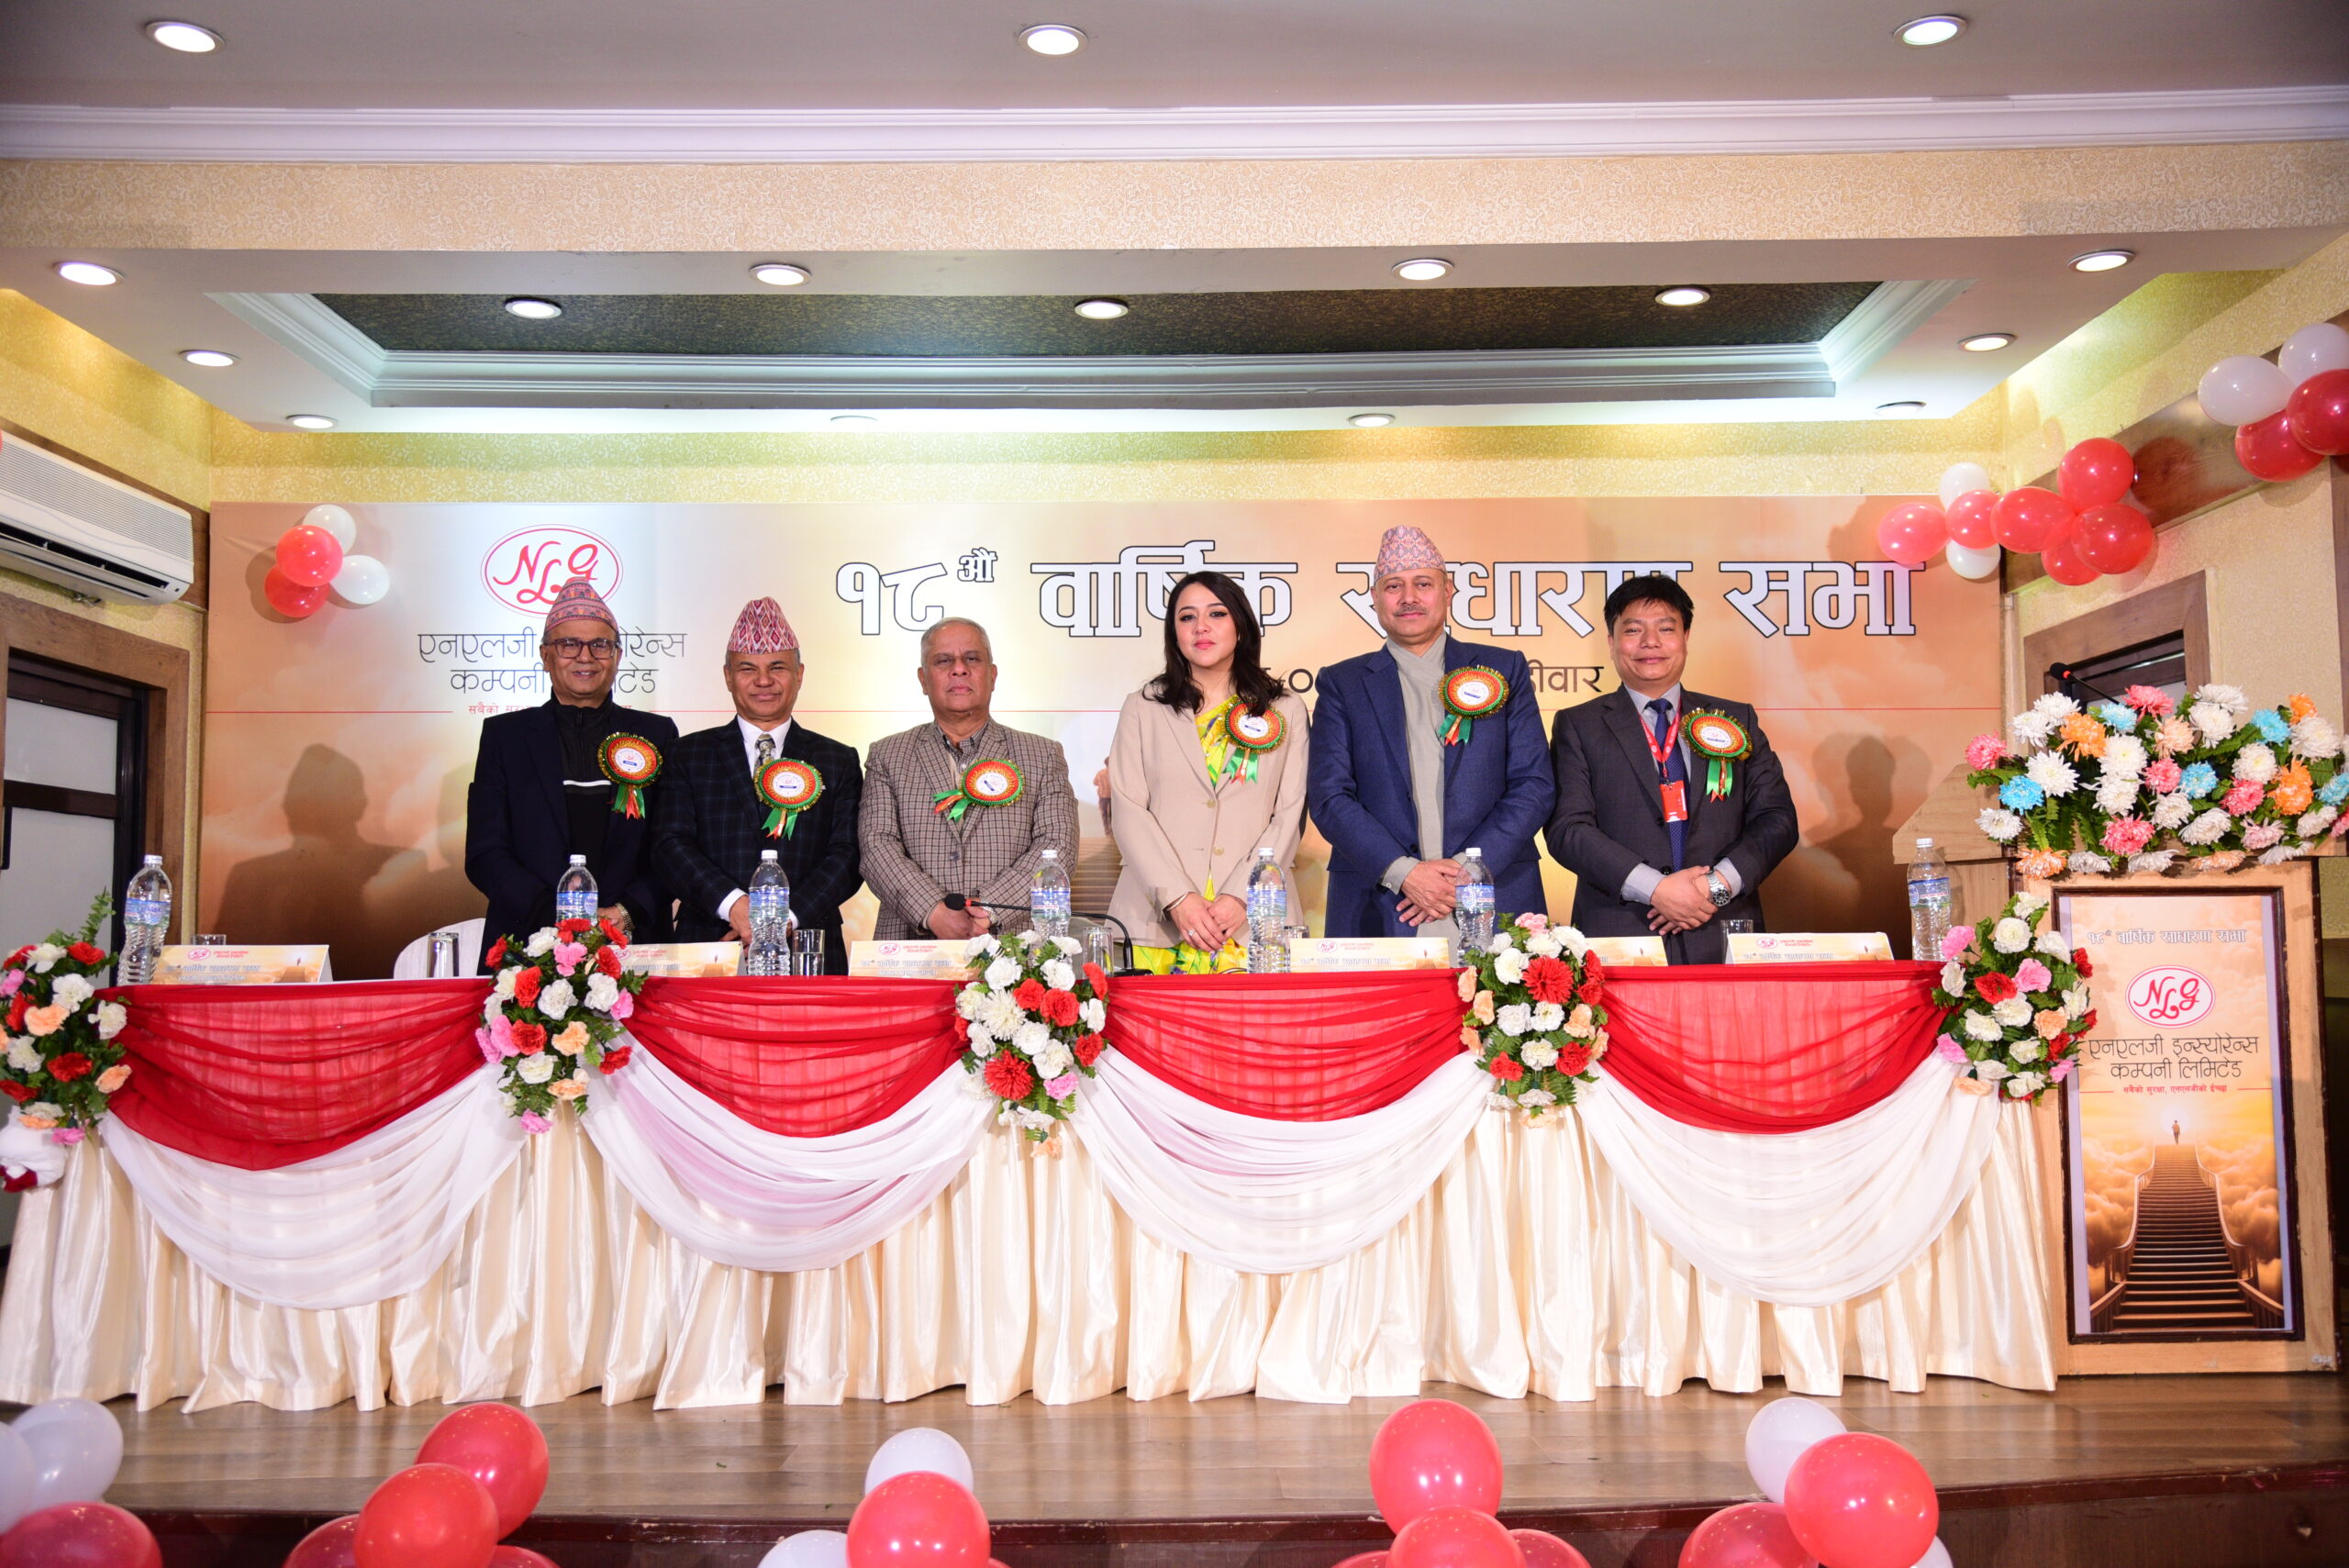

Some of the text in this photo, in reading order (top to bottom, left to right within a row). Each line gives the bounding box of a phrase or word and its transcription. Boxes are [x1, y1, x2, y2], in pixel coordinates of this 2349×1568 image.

[1719, 561, 1926, 638] सभा
[417, 627, 537, 663] एनएलजी
[451, 662, 546, 695] कम्पनी
[2088, 1034, 2165, 1060] एनएलजी
[2110, 1057, 2243, 1079] कम्पनी लिमिटेड
